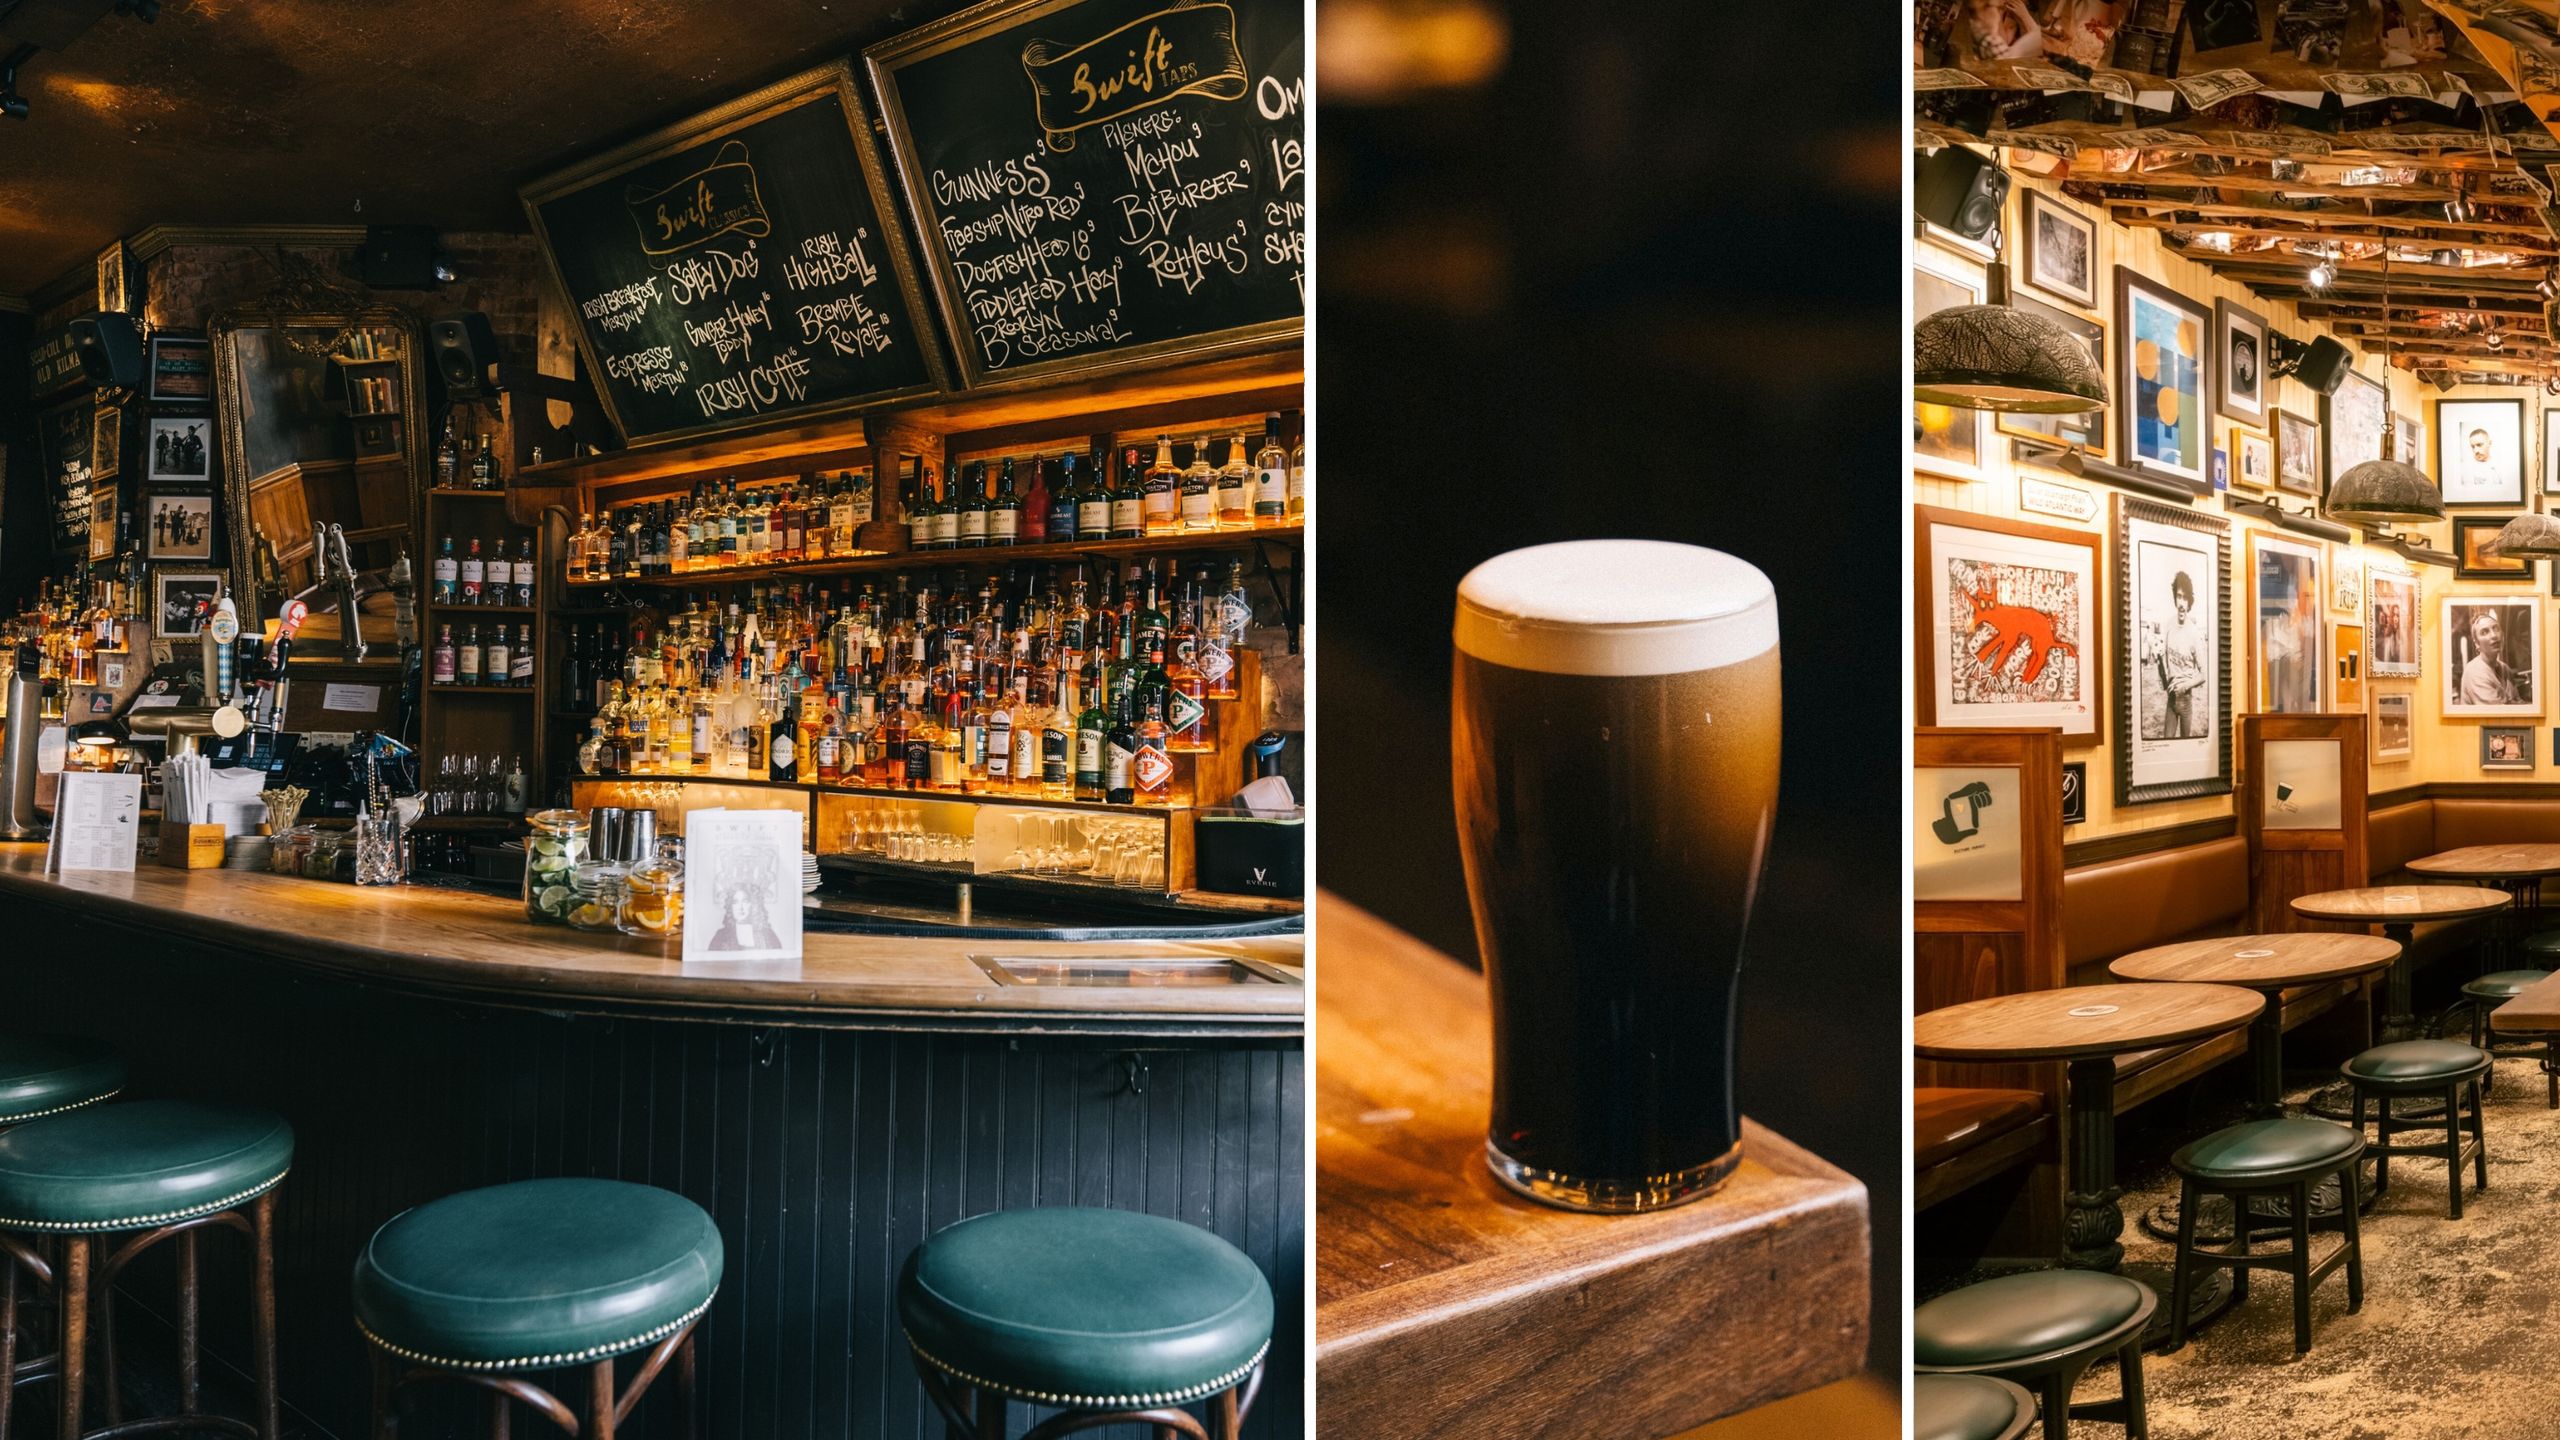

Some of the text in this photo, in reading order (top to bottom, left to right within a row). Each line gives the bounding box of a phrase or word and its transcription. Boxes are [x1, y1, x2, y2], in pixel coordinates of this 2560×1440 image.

[1071, 25, 1173, 113] Swift
[1160, 61, 1198, 88] TAPS
[933, 152, 1050, 206] GUINNESS
[657, 179, 714, 240] Swift
[1041, 196, 1081, 222] RED
[801, 231, 842, 259] IRISH
[705, 250, 759, 296] DOG
[582, 294, 610, 319] IRISH
[975, 304, 1064, 369] BROOKLYN
[37, 364, 52, 385] OLD
[606, 344, 674, 388] ESPRESSO
[695, 370, 760, 417] IRISH
[1172, 705, 1184, 719] P
[1142, 760, 1156, 776] P
